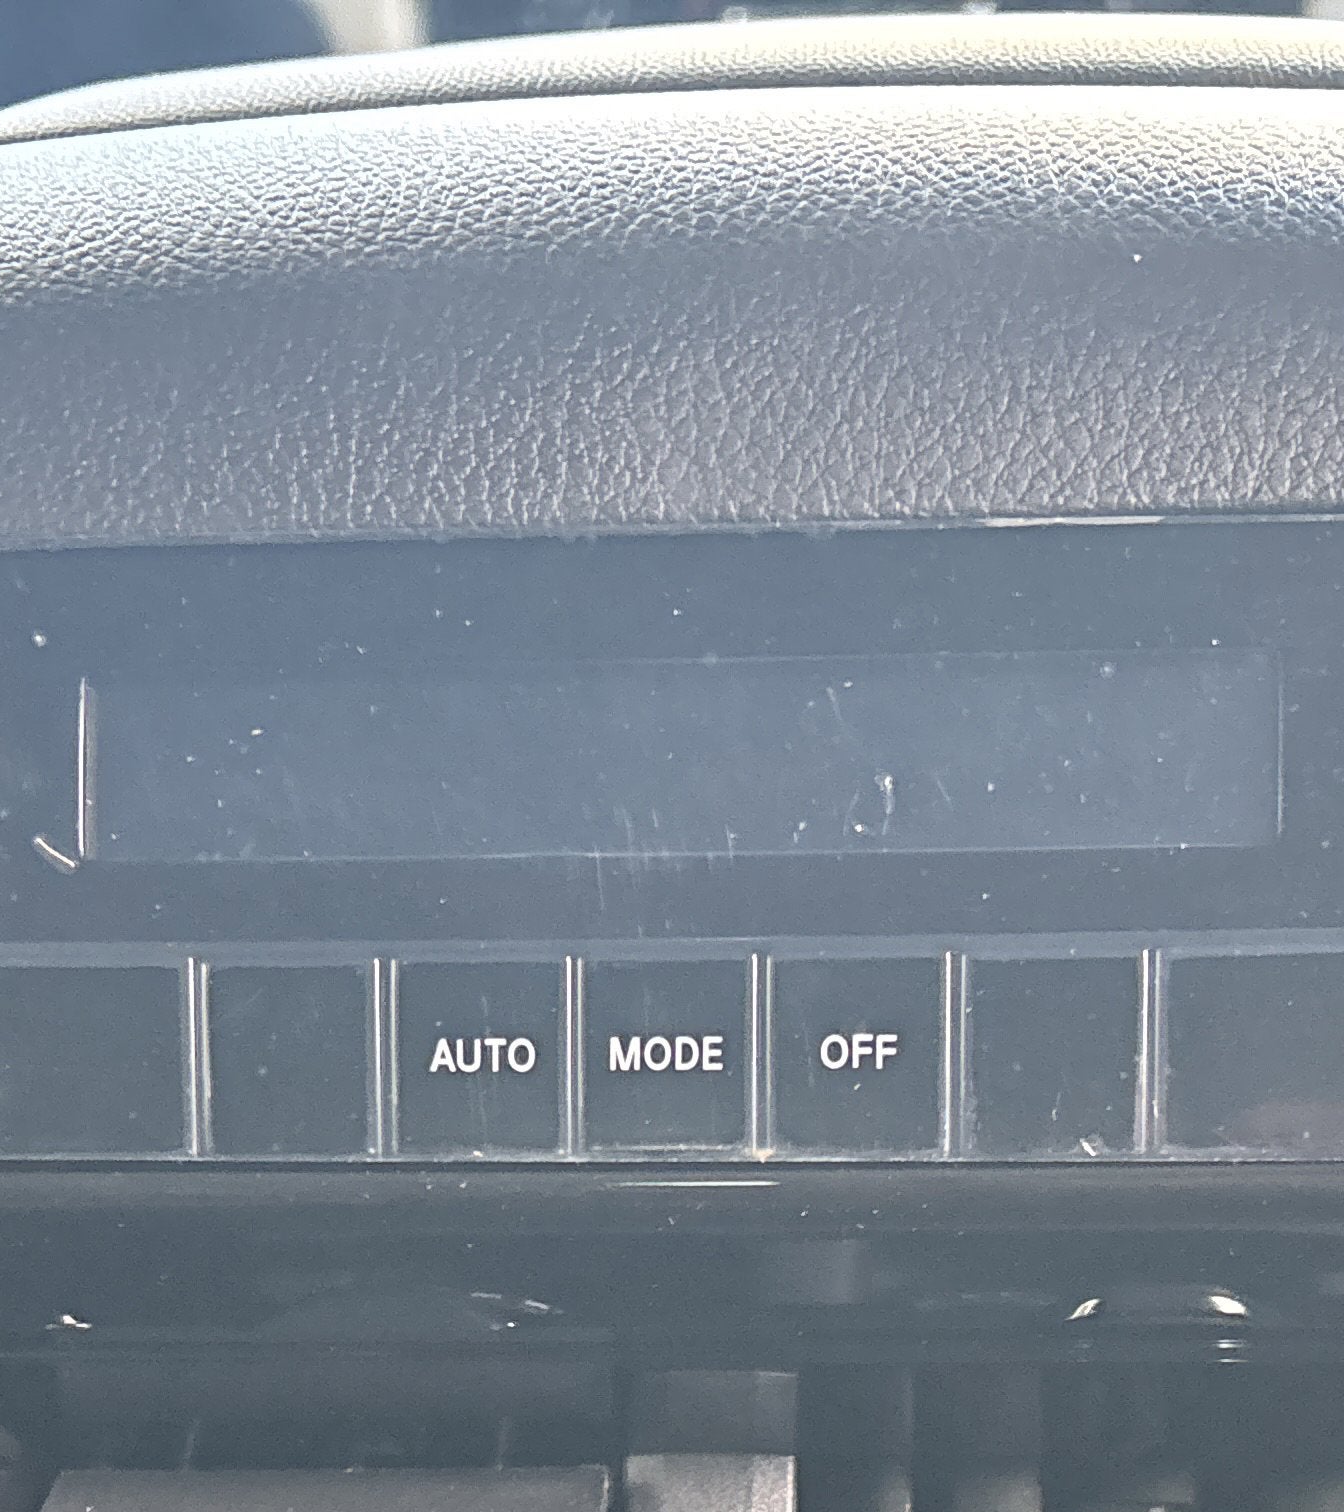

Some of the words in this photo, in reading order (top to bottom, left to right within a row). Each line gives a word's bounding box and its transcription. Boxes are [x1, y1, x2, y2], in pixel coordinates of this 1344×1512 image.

[429, 1037, 536, 1074] AUTO
[609, 1035, 724, 1072] MODE
[820, 1033, 898, 1070] OFF
